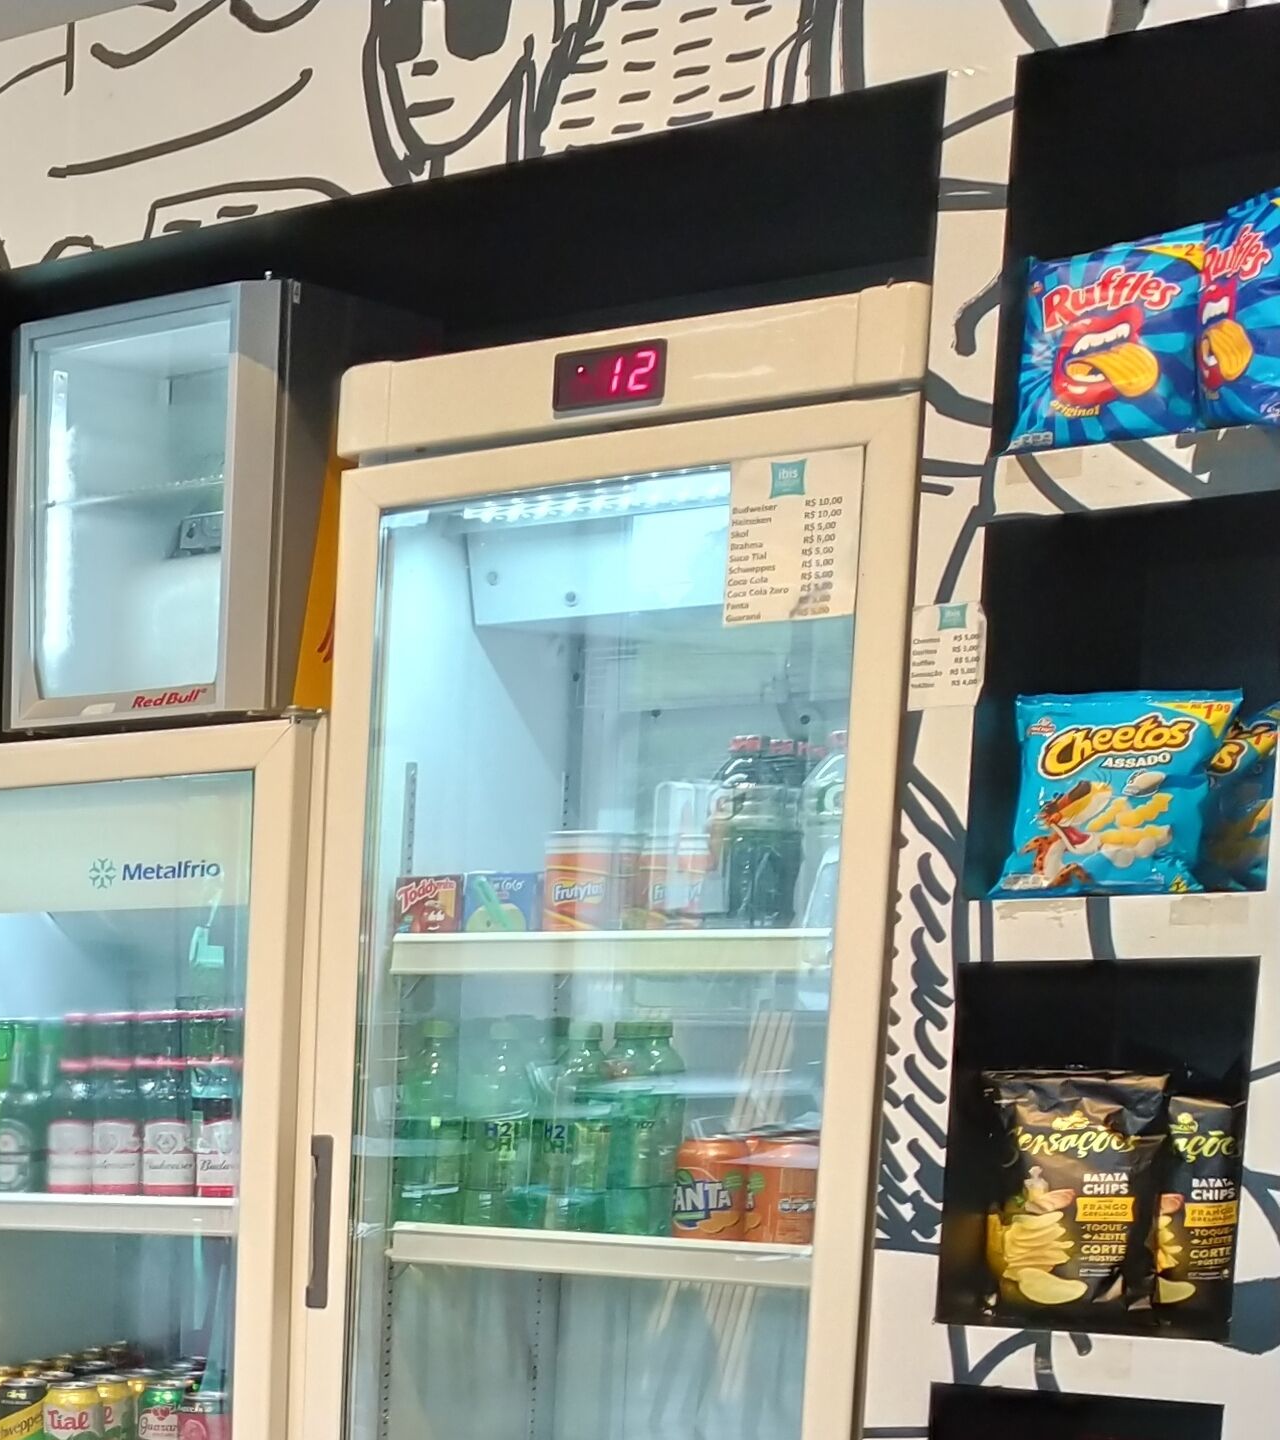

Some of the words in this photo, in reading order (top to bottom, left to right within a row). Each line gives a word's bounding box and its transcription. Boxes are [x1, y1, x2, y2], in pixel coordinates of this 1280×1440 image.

[1200, 223, 1272, 290] Ruffles
[1042, 266, 1181, 332] Ruffles
[611, 350, 656, 393] 12
[778, 468, 798, 480] ibis
[732, 504, 777, 514] Budweiser
[1040, 714, 1197, 778] Cheetos
[1102, 752, 1171, 769] ASSADO
[122, 859, 220, 882] Metalfrio
[1083, 1172, 1129, 1182] BATATA
[673, 1181, 732, 1211] ANTA
[1082, 1183, 1129, 1194] CHIPS
[1191, 1187, 1235, 1200] CHIPS
[1082, 1203, 1128, 1211] FRANGO
[1081, 1244, 1127, 1254] CORTE
[48, 1407, 89, 1430] Tial
